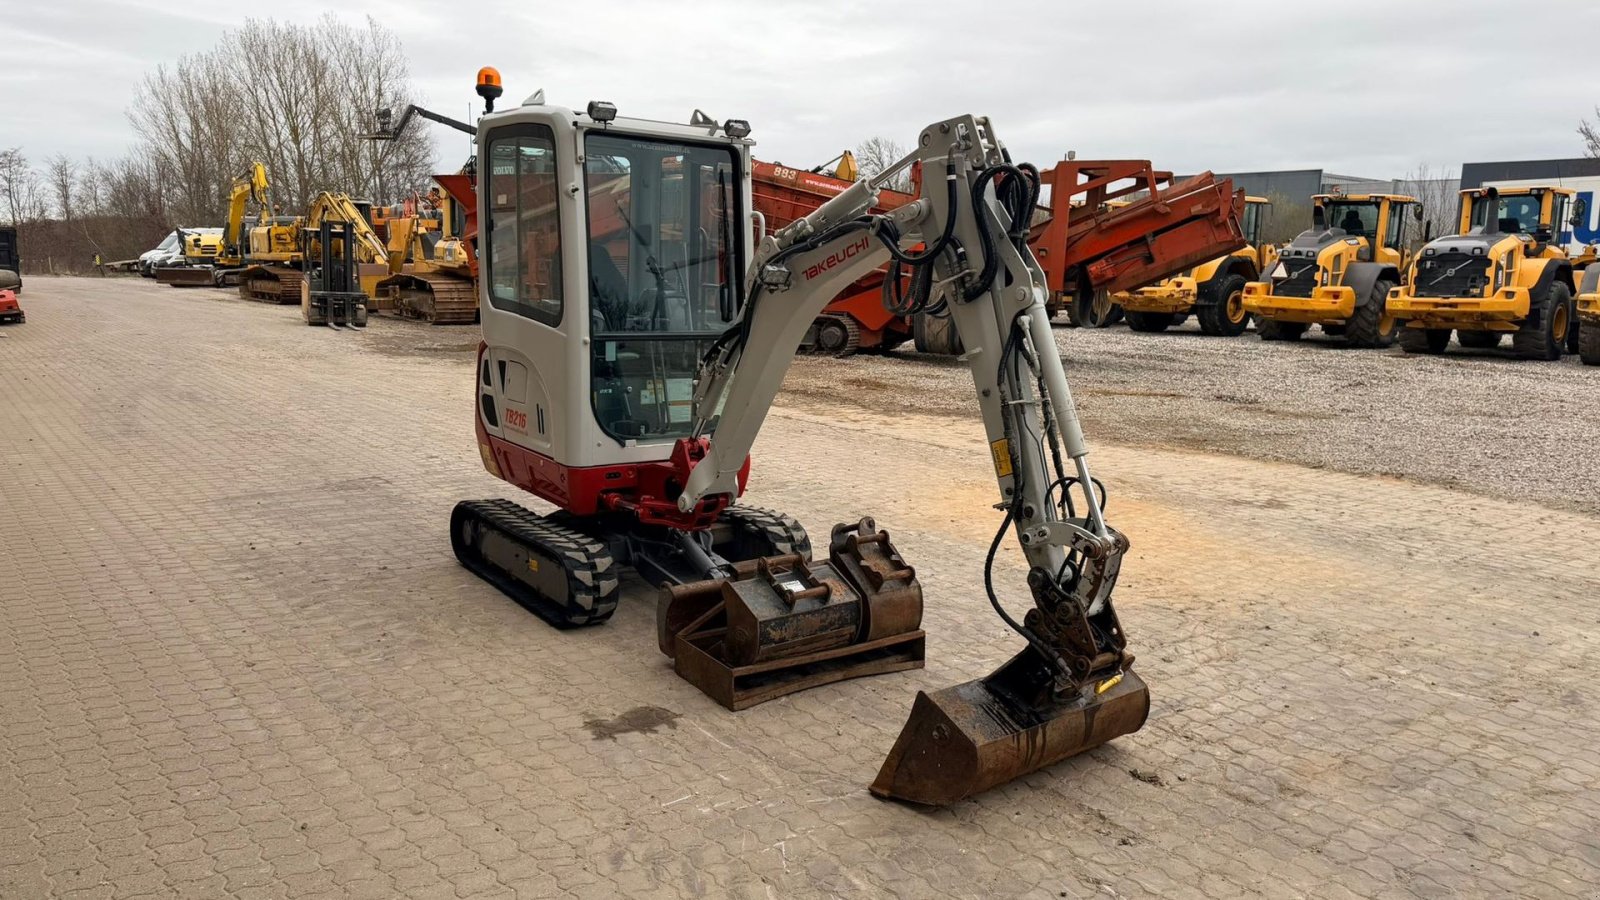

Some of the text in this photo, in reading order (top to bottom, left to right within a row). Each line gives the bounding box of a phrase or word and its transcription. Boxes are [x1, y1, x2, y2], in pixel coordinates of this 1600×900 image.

[773, 166, 797, 180] 883
[802, 236, 869, 281] TAKEUCHI
[505, 407, 526, 429] TB216
